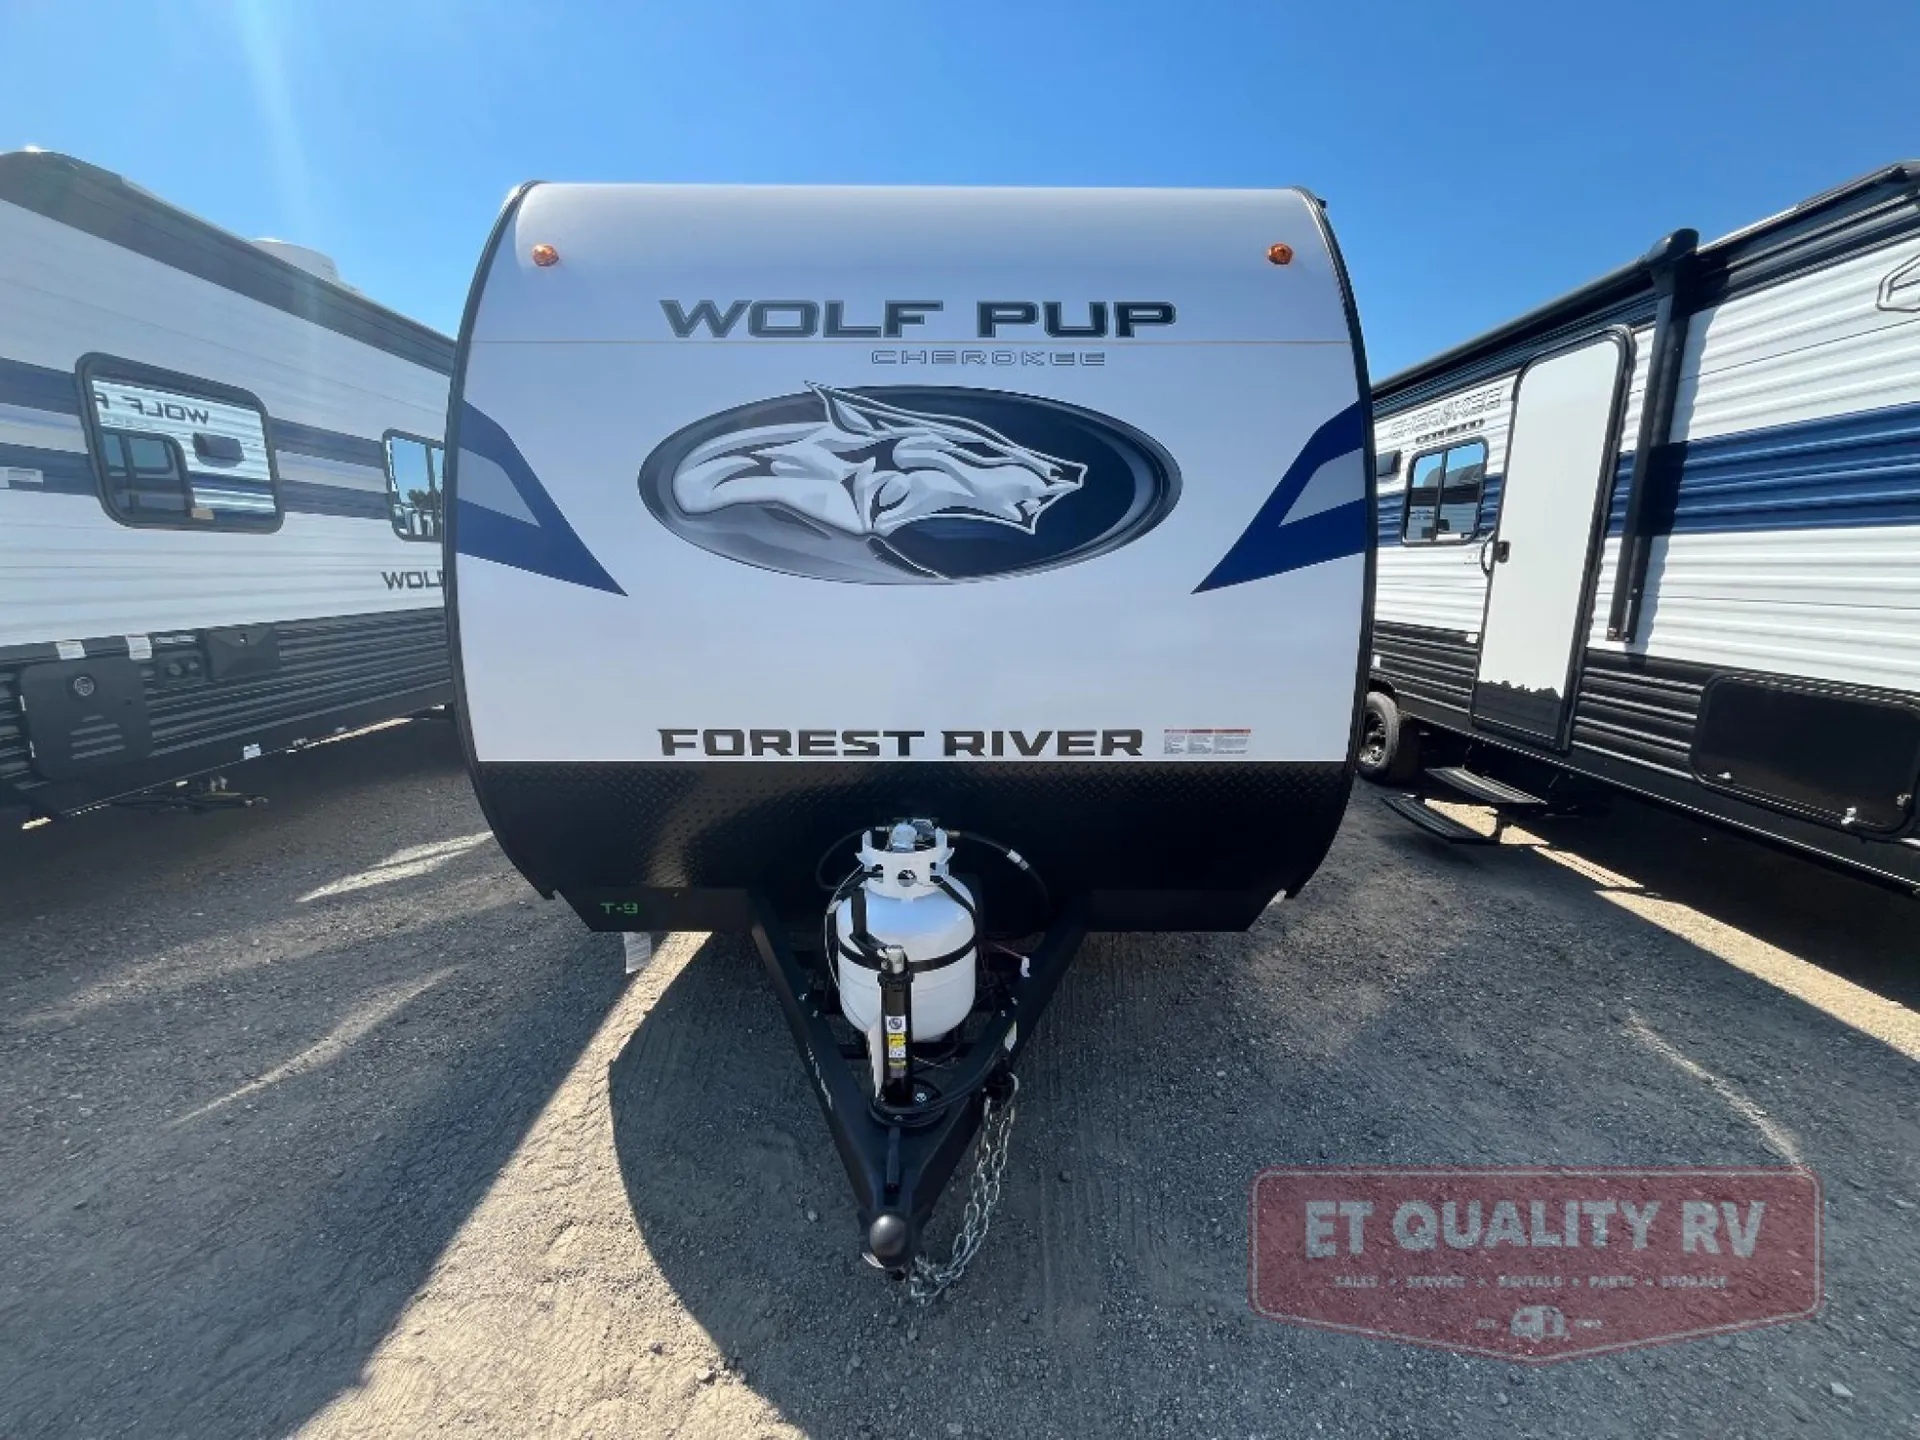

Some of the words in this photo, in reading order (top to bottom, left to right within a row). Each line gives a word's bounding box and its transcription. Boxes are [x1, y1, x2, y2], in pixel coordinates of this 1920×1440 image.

[658, 299, 943, 338] WOLF
[976, 300, 1177, 338] PUP
[871, 349, 1106, 366] CHEROKEE
[657, 728, 925, 756] FOREST
[940, 728, 1144, 756] RIVER
[600, 902, 638, 914] T-9
